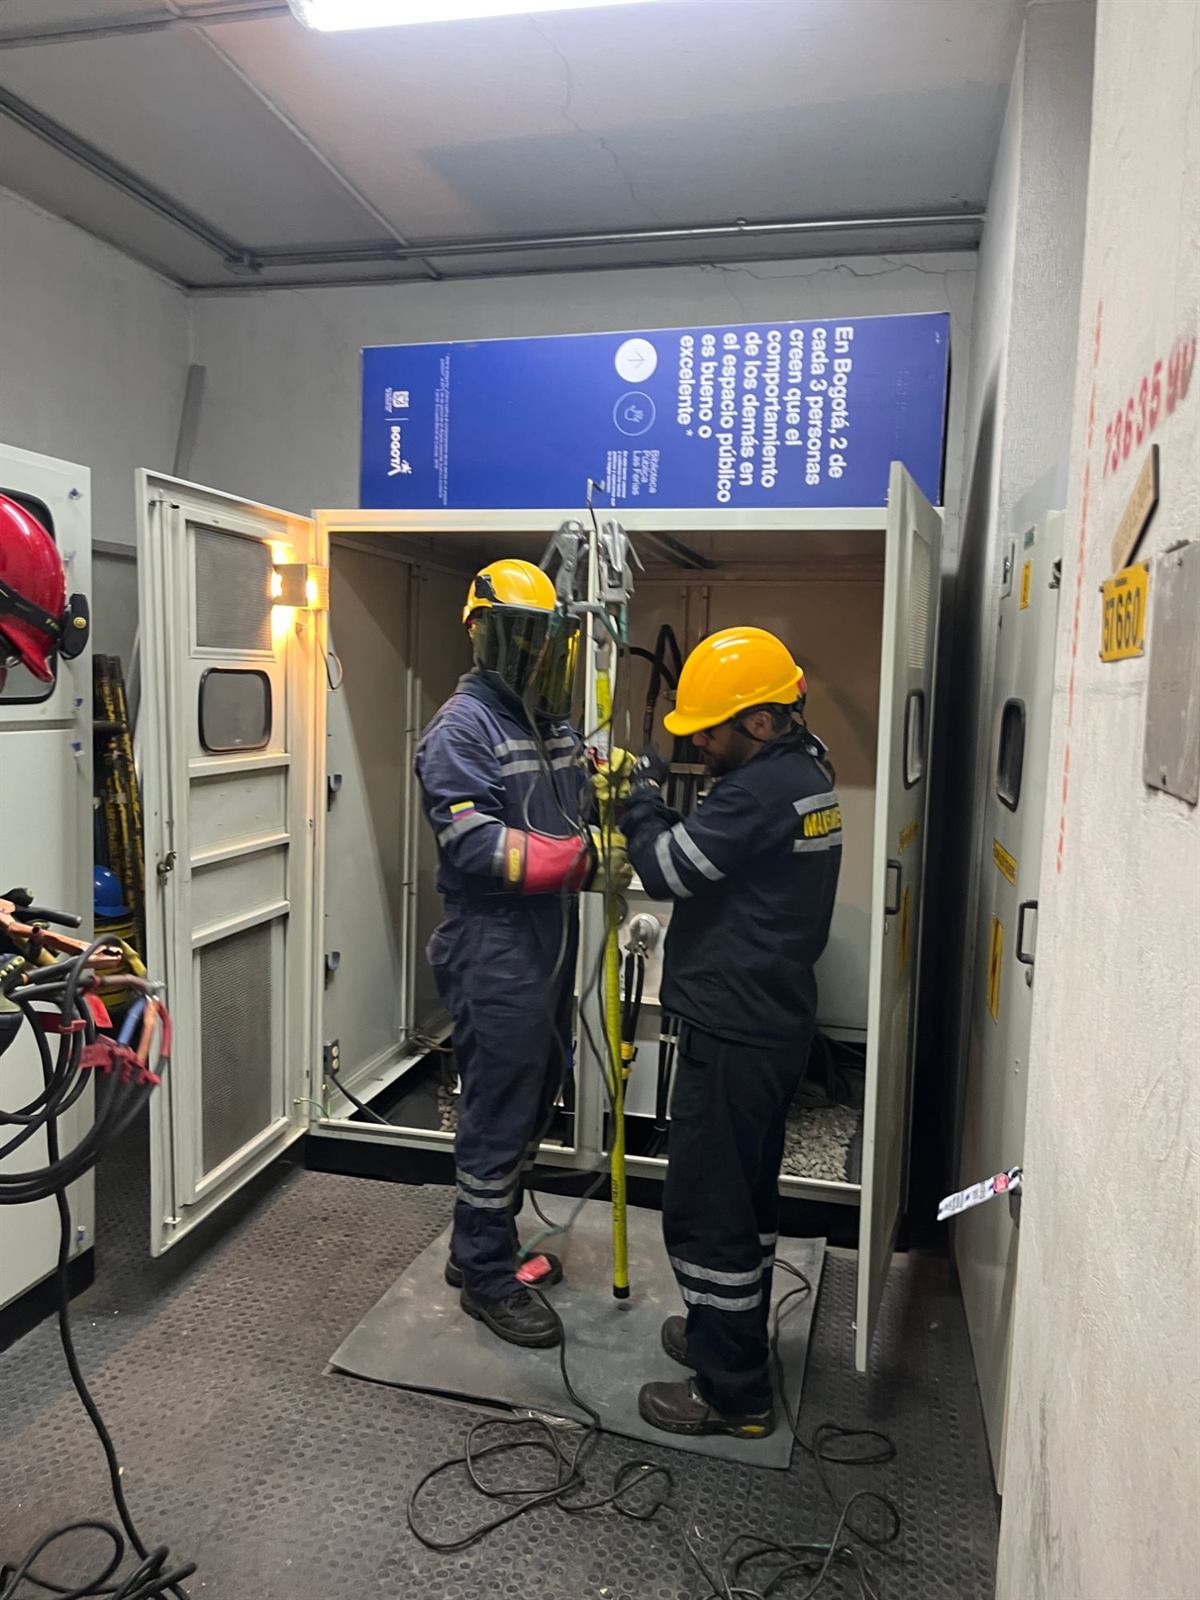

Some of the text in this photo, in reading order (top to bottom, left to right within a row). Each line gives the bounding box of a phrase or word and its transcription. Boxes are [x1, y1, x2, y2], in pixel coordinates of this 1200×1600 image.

[677, 335, 696, 425] excelente
[698, 334, 717, 438] es bueno o
[716, 332, 741, 502] el espacio público
[739, 331, 762, 485] de los demás en
[760, 330, 782, 488] comportamiento
[783, 329, 804, 445] creen que el
[805, 327, 828, 485] cada 3 personas
[827, 326, 854, 478] En Bogotá, 2 de
